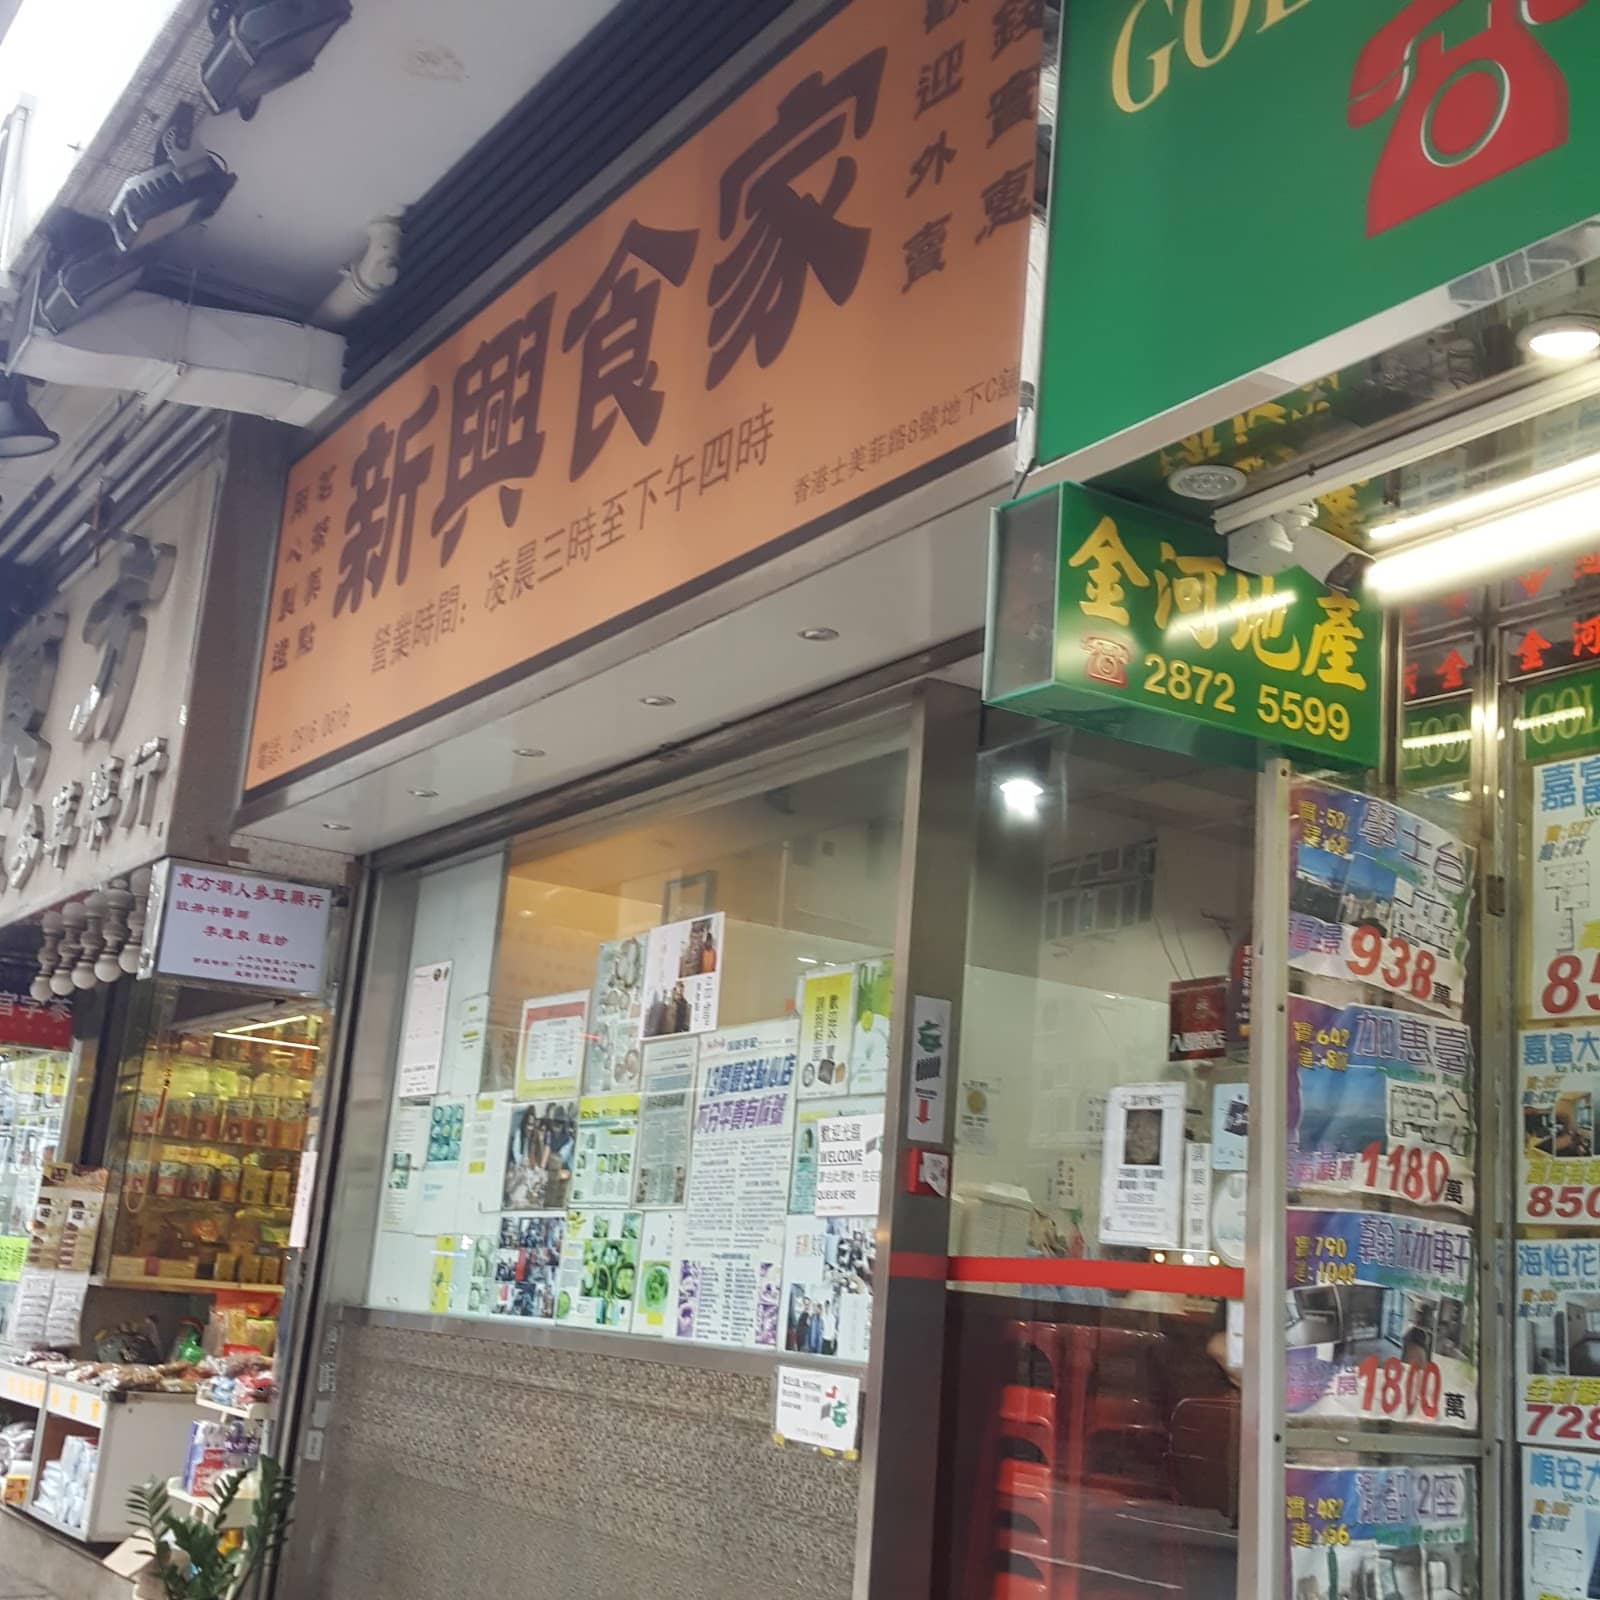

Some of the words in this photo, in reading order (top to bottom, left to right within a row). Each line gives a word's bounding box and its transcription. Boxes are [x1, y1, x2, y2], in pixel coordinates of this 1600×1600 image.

[332, 46, 889, 618] 新興食家
[484, 402, 777, 614] 凌晨三時至下午四時
[1069, 514, 1368, 691] 金河地產
[1143, 652, 1237, 713] 2872
[1256, 684, 1352, 742] 5599
[1346, 924, 1436, 1000] 938
[820, 1149, 864, 1164] WELCOME
[1360, 1140, 1449, 1203] 1180
